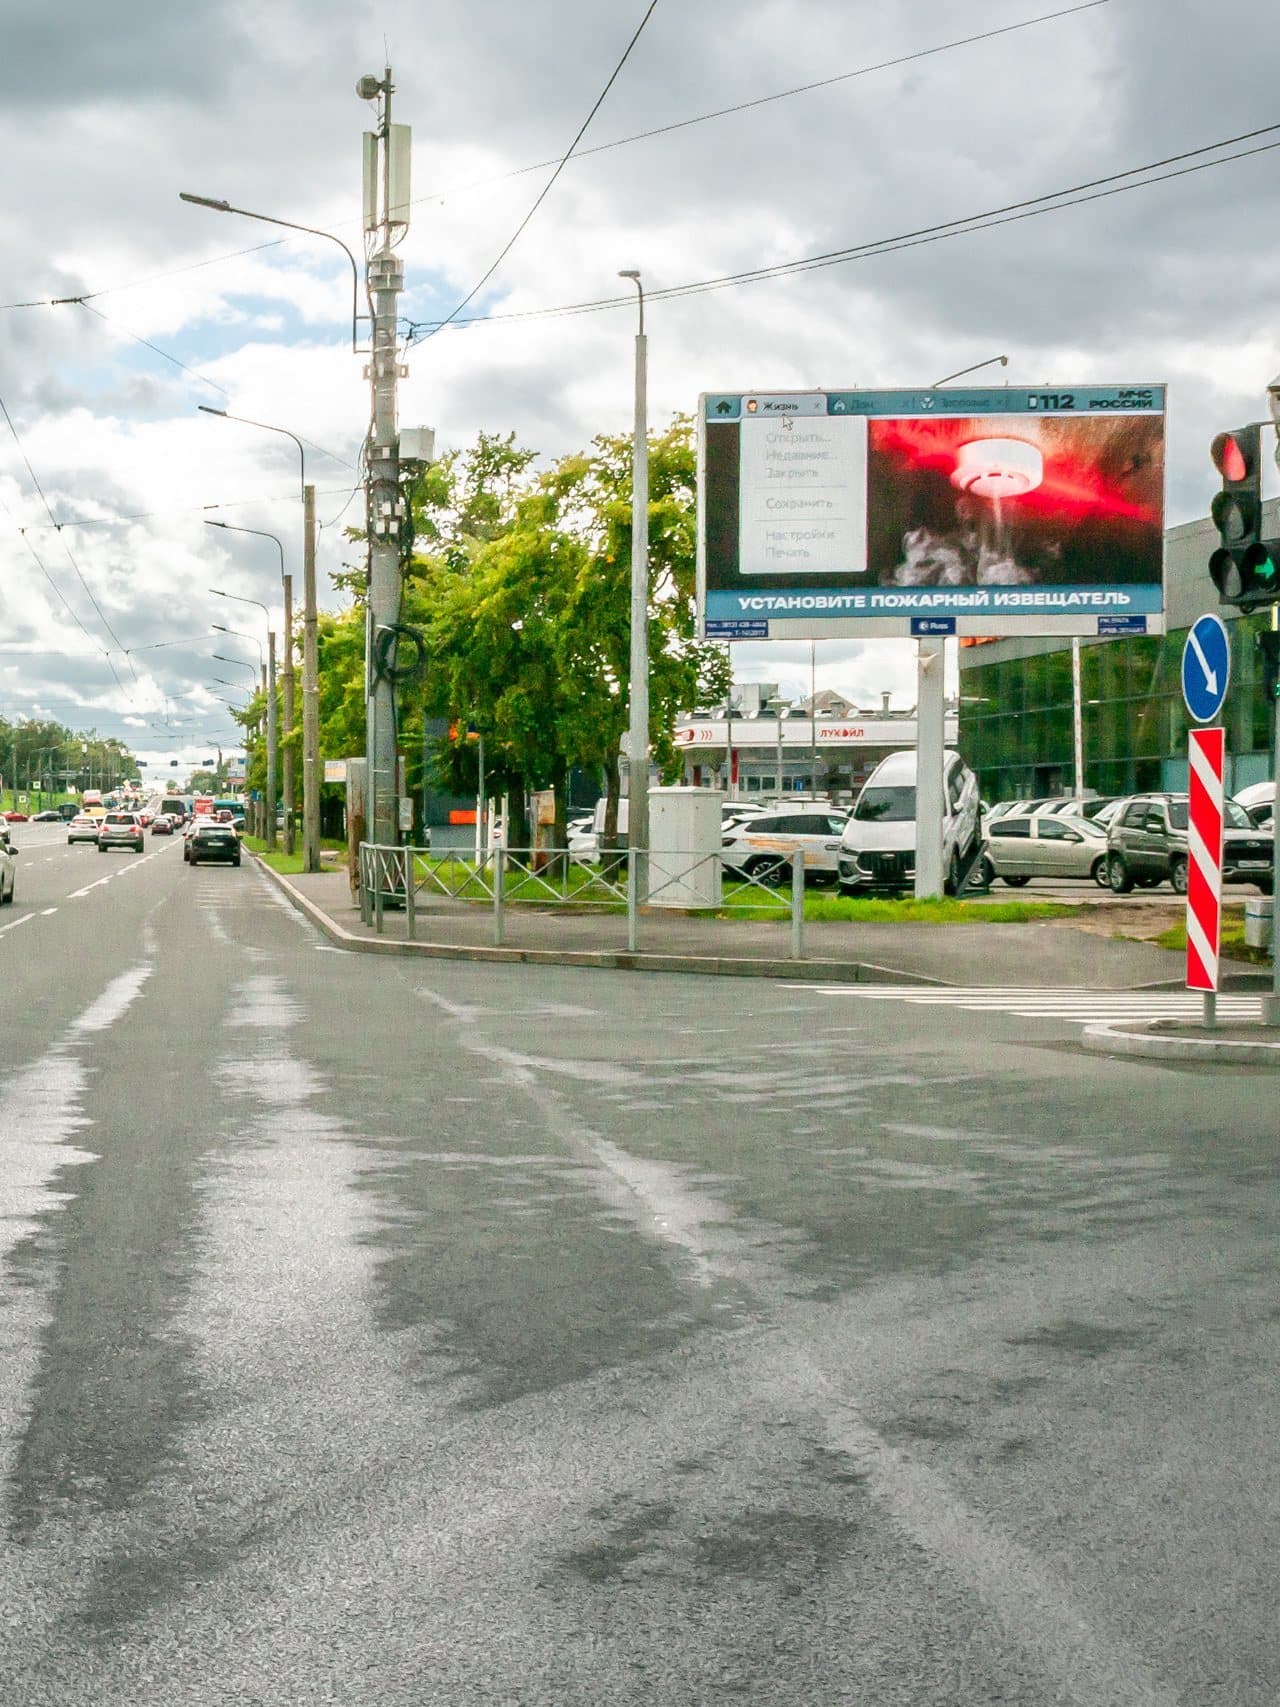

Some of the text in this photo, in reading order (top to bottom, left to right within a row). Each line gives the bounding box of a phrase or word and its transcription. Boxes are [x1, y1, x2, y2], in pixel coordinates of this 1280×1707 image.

[1119, 390, 1152, 398] МЧС
[763, 401, 799, 411] Жизнь
[1040, 394, 1075, 409] 112
[1089, 399, 1153, 408] РОССИИ
[766, 498, 833, 510] Сохранить
[766, 529, 835, 542] Настройки
[738, 590, 1131, 610] УСТАНОВИТЕ ПОЖАРНЫЙ ИЗВЕЩАТЕЛЬ
